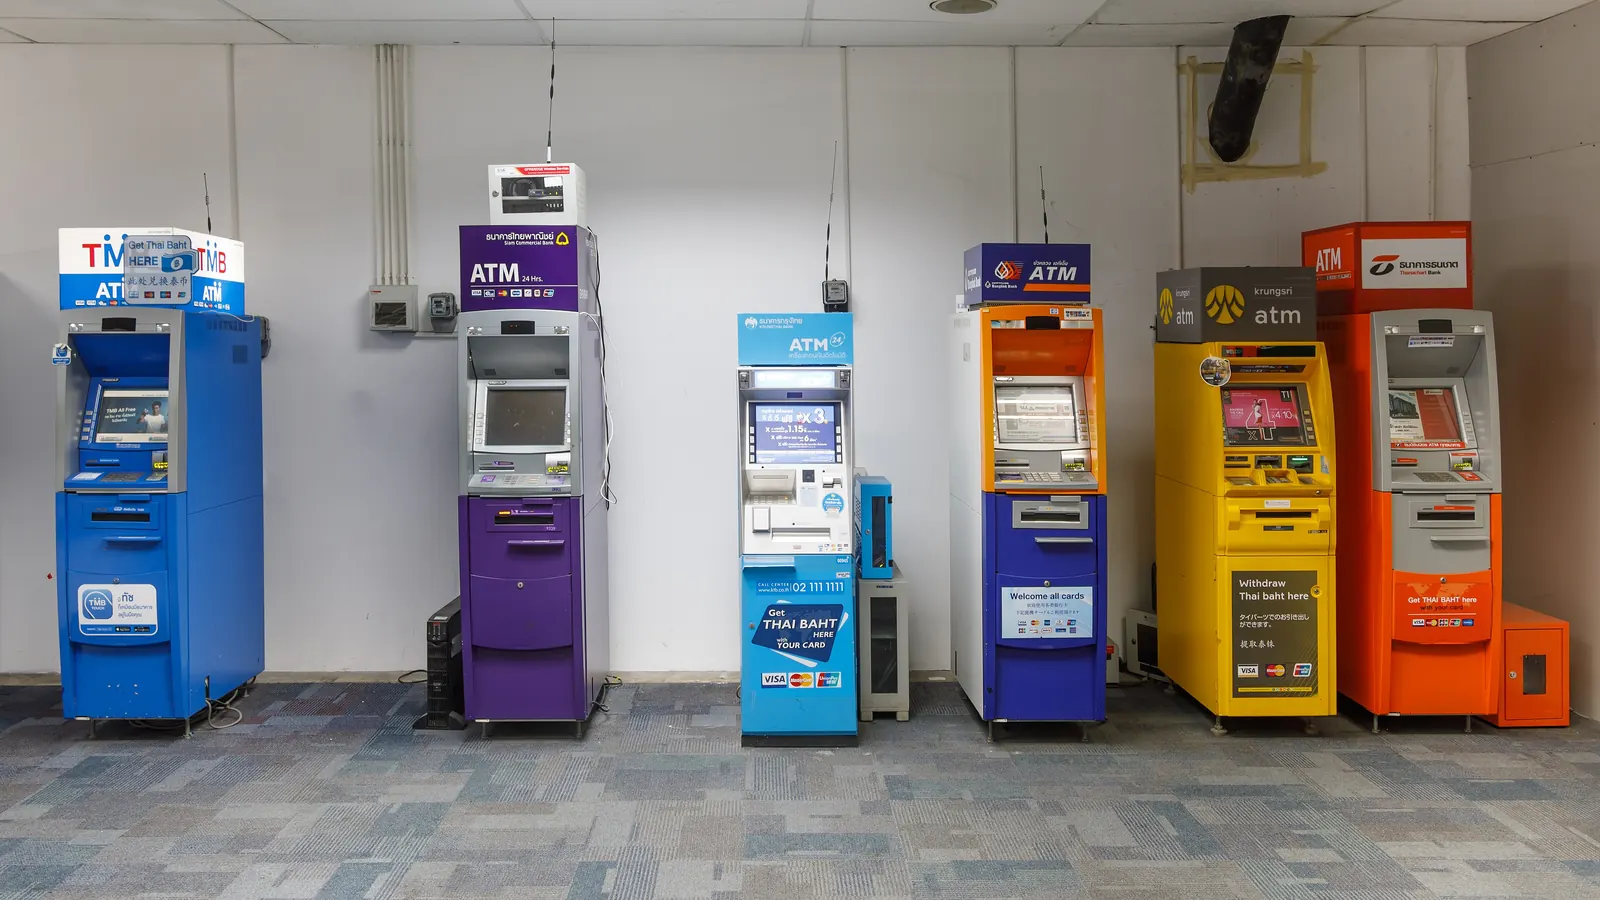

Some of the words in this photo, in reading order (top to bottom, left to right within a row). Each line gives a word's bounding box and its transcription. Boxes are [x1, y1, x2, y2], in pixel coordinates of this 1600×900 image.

[486, 231, 554, 240] ธนาคารไทยพาณิชย์
[128, 241, 144, 250] Get
[146, 240, 165, 249] Thai
[166, 240, 187, 250] Baht
[128, 256, 158, 266] HERE
[198, 240, 226, 273] TMB
[1316, 247, 1341, 272] ATM
[470, 263, 520, 282] ATM
[1028, 266, 1077, 280] ATM
[128, 276, 188, 286] 此处兑换泰币
[96, 277, 125, 298] AT
[202, 281, 222, 302] ATM
[1176, 287, 1191, 298] krungsri
[1254, 286, 1293, 297] krungsri
[1176, 308, 1194, 325] atm
[1255, 306, 1301, 324] atm
[789, 338, 828, 351] ATM
[792, 582, 806, 592] 02
[809, 582, 823, 592] 111
[825, 582, 844, 592] 1111
[1239, 579, 1286, 587] Withdraw
[1239, 592, 1260, 600] Thai
[1263, 592, 1285, 600] baht
[1288, 592, 1309, 600] here
[89, 598, 106, 606] TMB
[763, 620, 796, 629] THAI
[800, 619, 838, 628] BAHT
